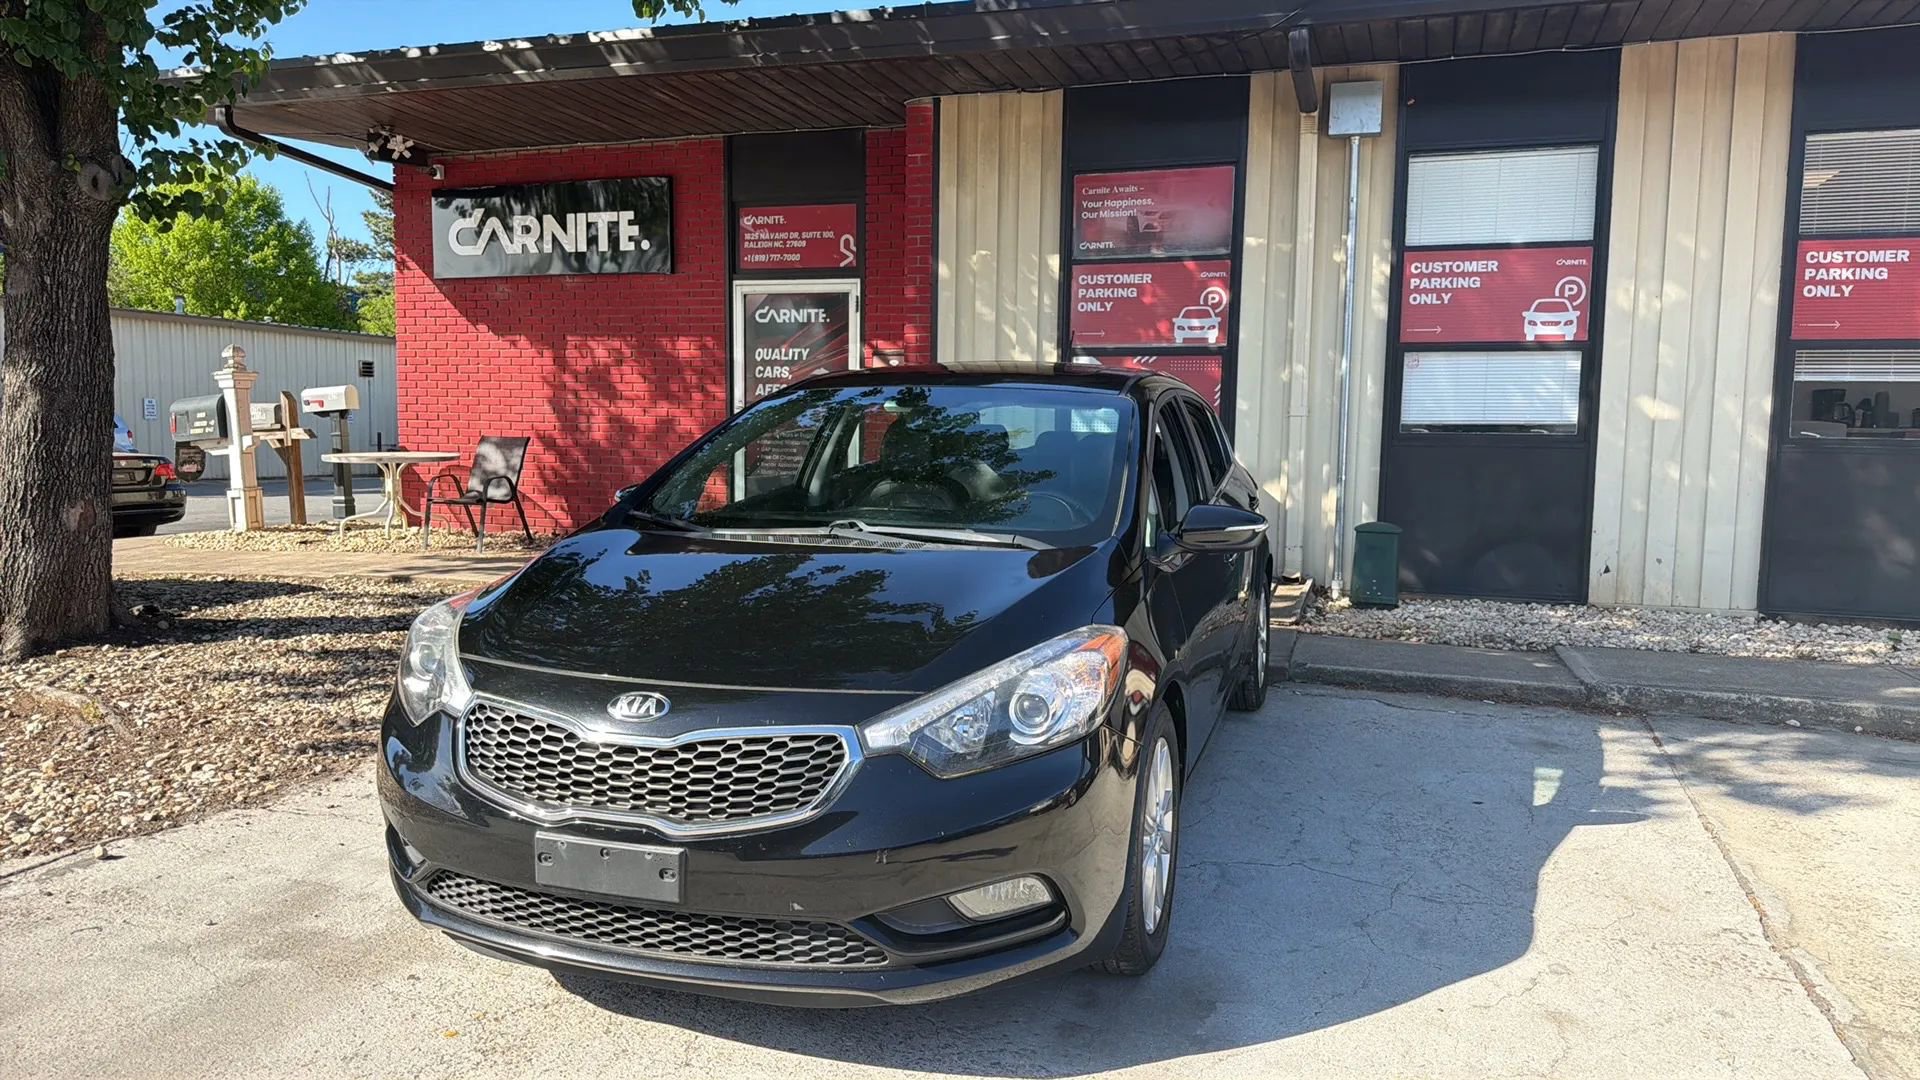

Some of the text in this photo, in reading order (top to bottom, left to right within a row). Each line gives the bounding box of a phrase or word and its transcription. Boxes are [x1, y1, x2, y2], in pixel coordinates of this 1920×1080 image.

[1082, 187, 1110, 195] Carnite
[1112, 185, 1138, 194] Awaits
[1082, 200, 1104, 209] Your
[1081, 208, 1137, 220] Our Mission!
[760, 232, 788, 240] NAVAHO
[801, 231, 821, 239] SUITE
[744, 240, 772, 249] RALEIGH
[1806, 250, 1910, 264] CUSTOMER
[1410, 260, 1498, 273] CUSTOMER
[1078, 273, 1152, 285] CUSTOMER
[1804, 268, 1888, 281] PARKING
[1410, 277, 1481, 289] PARKING
[1078, 288, 1137, 298] PARKING
[1803, 285, 1854, 297] ONLY
[1409, 293, 1452, 304] ONLY
[1078, 302, 1113, 312] ONLY
[755, 348, 810, 362] QUALITY
[755, 366, 792, 380] CARS,
[616, 696, 657, 715] KIA
